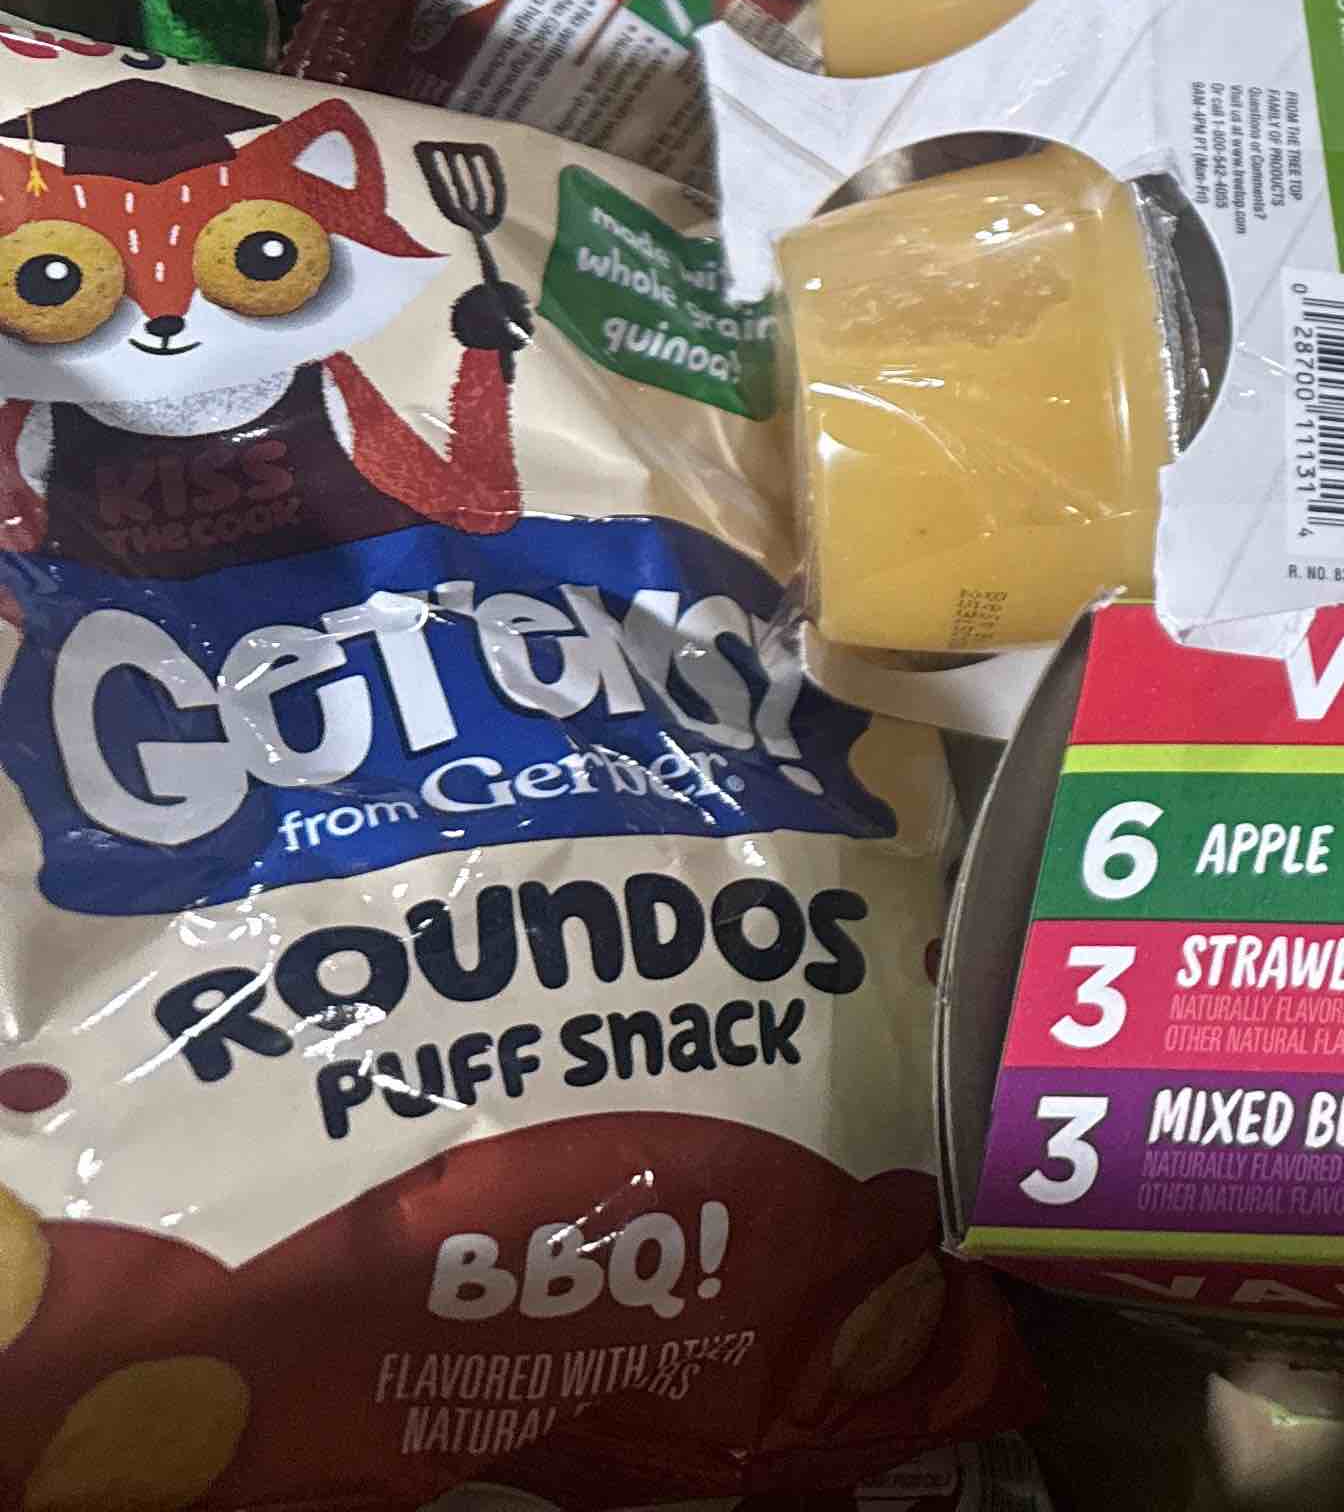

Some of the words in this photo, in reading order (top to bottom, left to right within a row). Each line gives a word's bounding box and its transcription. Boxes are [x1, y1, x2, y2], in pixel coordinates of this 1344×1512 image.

[577, 245, 678, 310] whole
[1293, 326, 1316, 402] 28700
[1296, 418, 1317, 495] 11131
[1300, 526, 1313, 538] 4
[279, 795, 419, 854] from
[421, 750, 730, 821] Gerber
[1081, 800, 1164, 900] 6
[1196, 823, 1335, 876] APPLE
[1048, 945, 1137, 1049] 3
[1169, 994, 1272, 1022] NATURALLY
[316, 1023, 543, 1140] PUFF
[1018, 1095, 1109, 1206] 3
[1148, 1088, 1296, 1148] MIXED
[426, 1202, 731, 1320] BBQ!
[375, 1351, 554, 1403] FLAVORED
[559, 1346, 650, 1397] WITH
